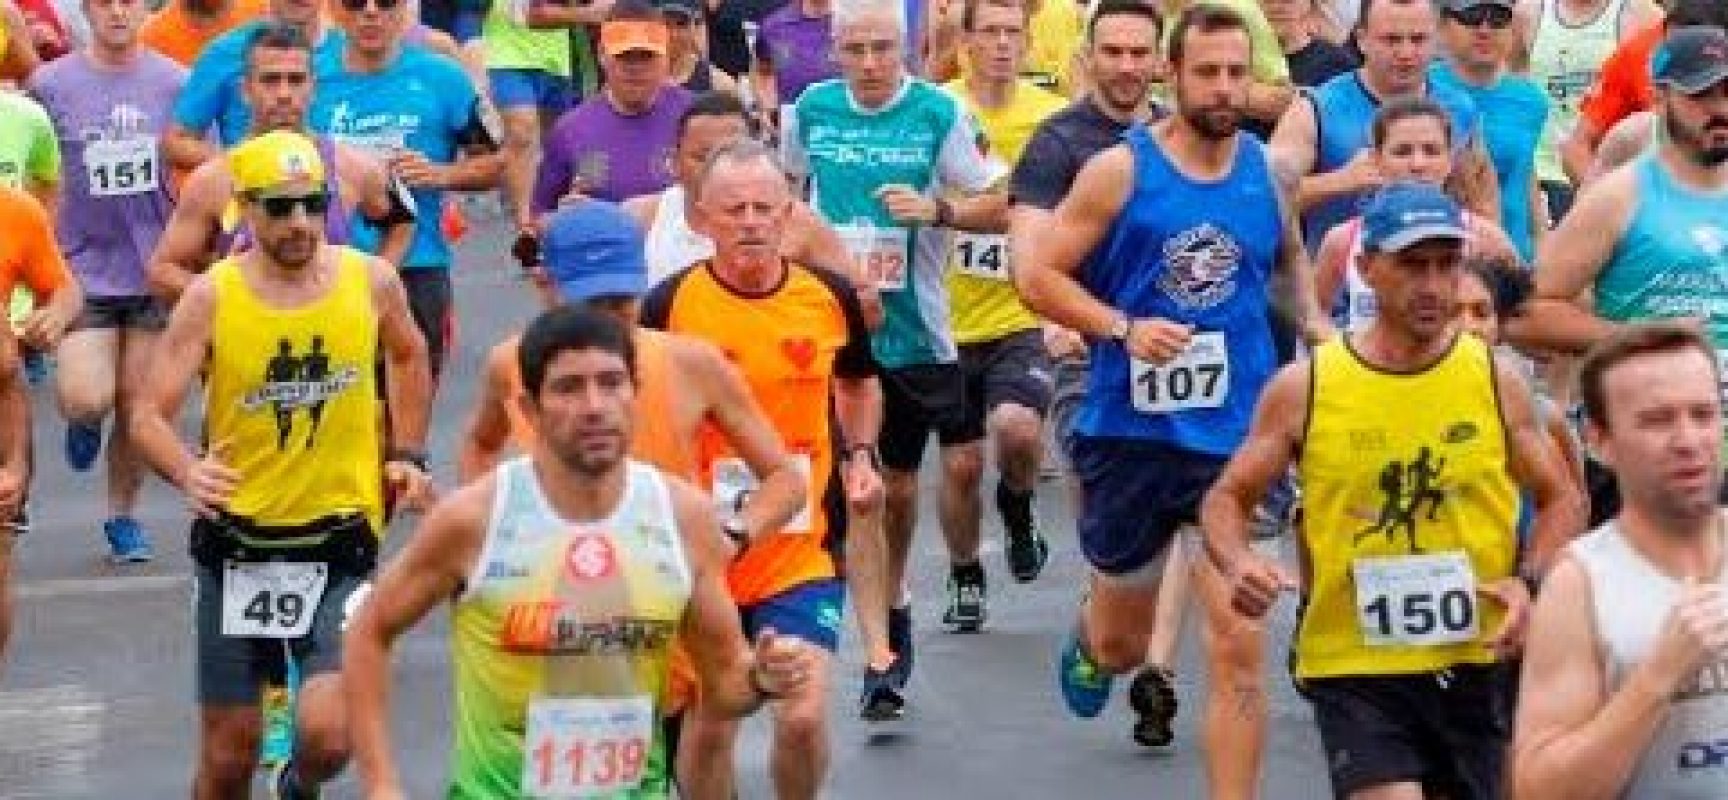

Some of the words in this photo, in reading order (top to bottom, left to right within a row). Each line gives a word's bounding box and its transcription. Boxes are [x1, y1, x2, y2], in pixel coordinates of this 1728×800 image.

[93, 159, 152, 187] 151
[957, 241, 1011, 271] 14
[1137, 363, 1225, 403] 107
[244, 591, 303, 628] 49
[1364, 590, 1473, 635] 150
[532, 736, 645, 787] 1139
